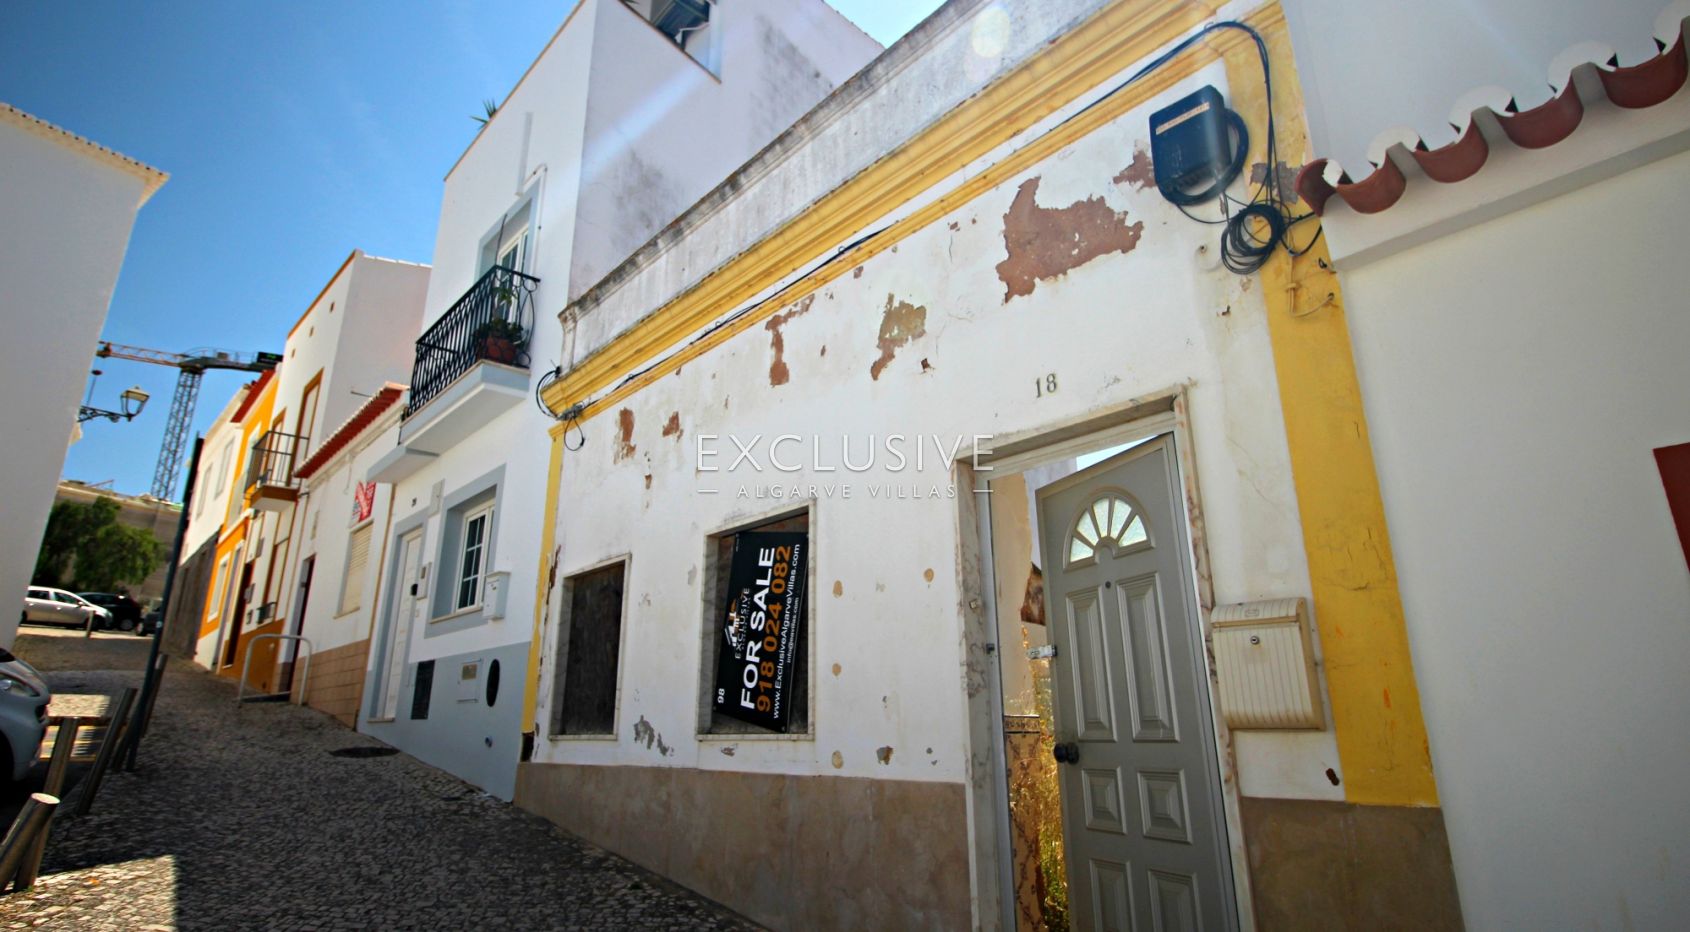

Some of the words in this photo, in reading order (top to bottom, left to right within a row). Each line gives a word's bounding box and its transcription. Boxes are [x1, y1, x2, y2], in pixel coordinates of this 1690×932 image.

[1035, 372, 1058, 399] 18
[750, 547, 775, 632] SALE
[771, 545, 792, 594] 082
[735, 588, 750, 660] EXCLUSIVE
[763, 602, 783, 652] 024
[773, 544, 800, 719] www.ExclusiveAlgarveVillas.com
[740, 640, 763, 710] FOR
[756, 665, 776, 713] 918
